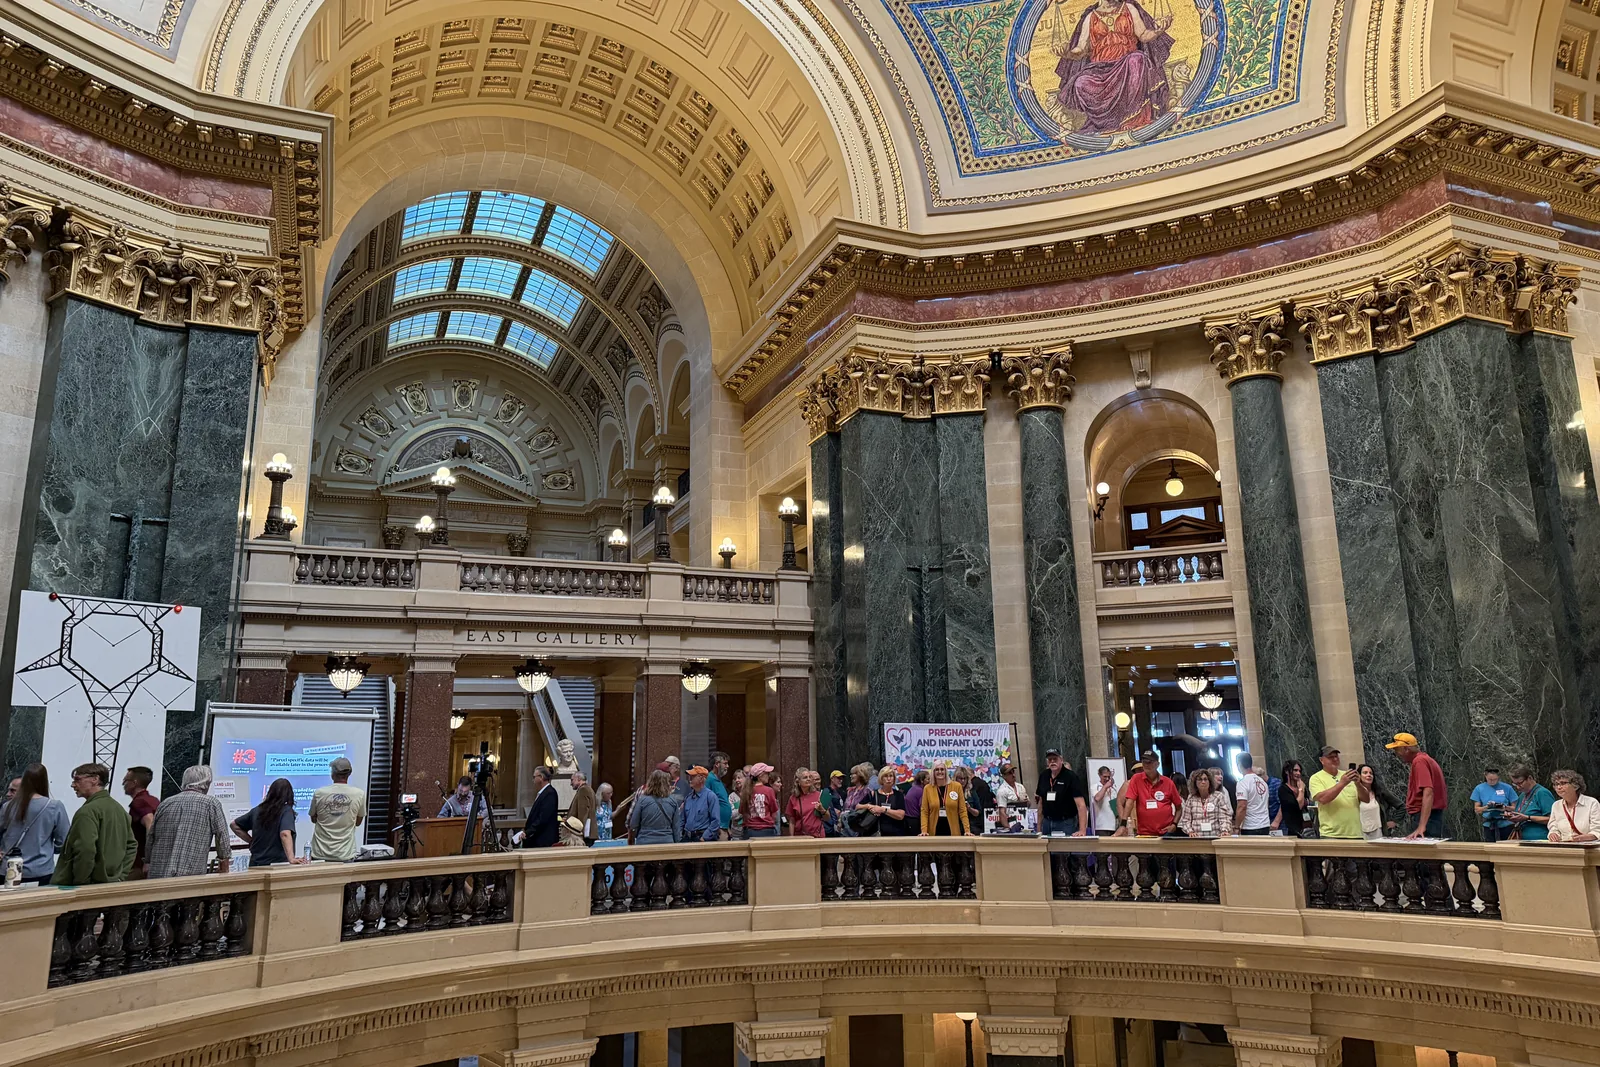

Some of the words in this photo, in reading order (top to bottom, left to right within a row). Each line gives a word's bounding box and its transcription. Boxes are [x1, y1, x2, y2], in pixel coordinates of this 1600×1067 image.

[466, 629, 522, 643] EAST
[536, 631, 638, 646] GALLERY
[928, 728, 982, 737] PREGNANCY
[916, 739, 937, 747] AND
[938, 739, 971, 747] INFANT
[972, 739, 994, 747] LOSS
[232, 749, 257, 765] #3
[919, 749, 975, 758] AWARENESS
[976, 749, 995, 758] DAY
